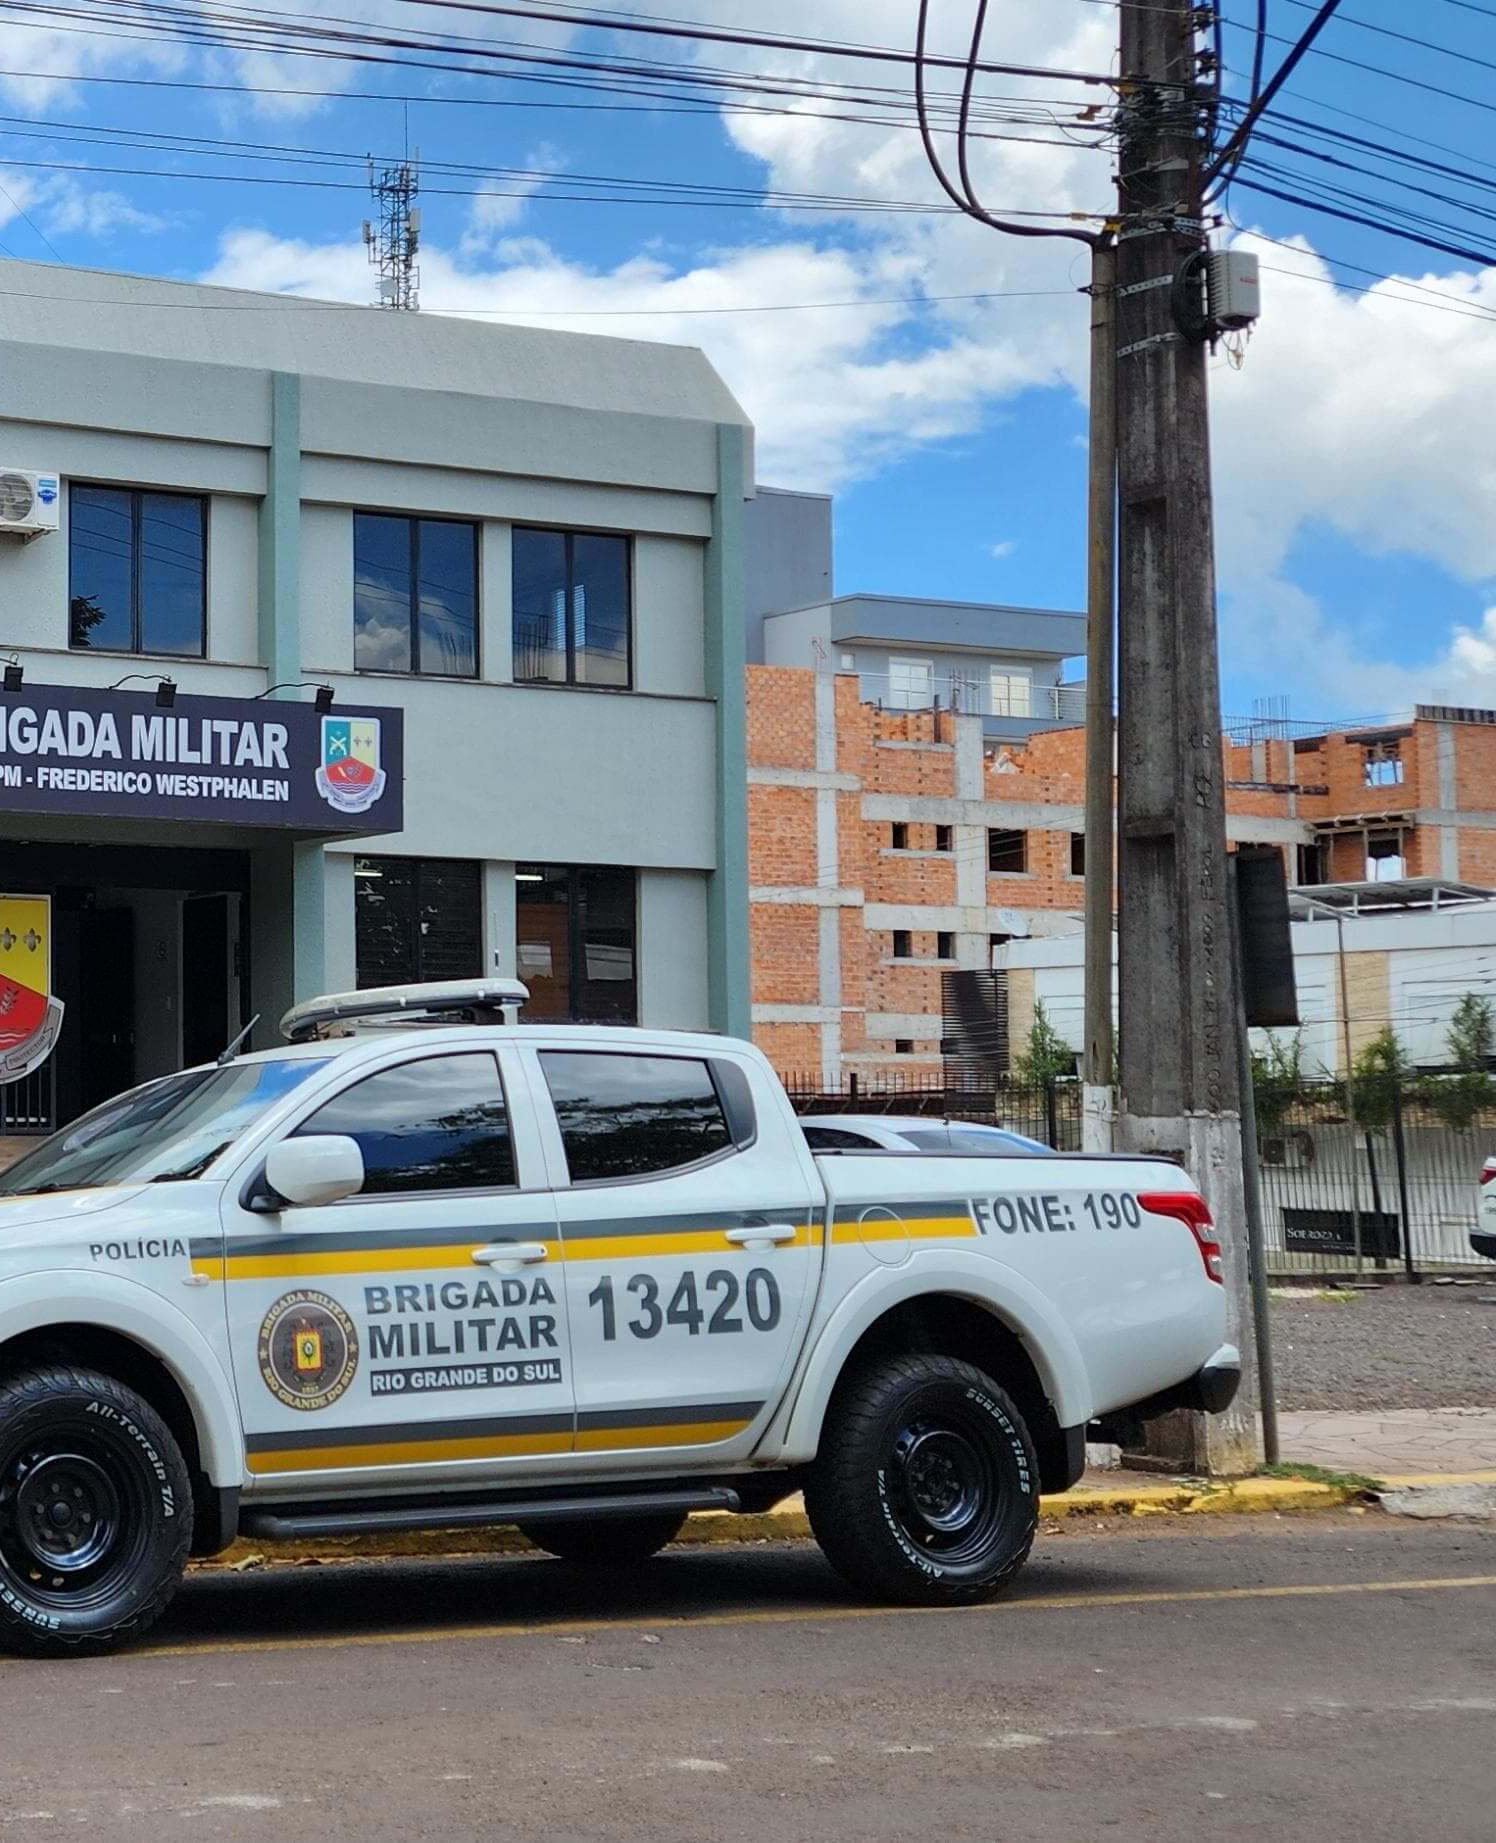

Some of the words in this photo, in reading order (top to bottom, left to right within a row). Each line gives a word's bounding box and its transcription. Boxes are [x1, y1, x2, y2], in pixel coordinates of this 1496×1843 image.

[131, 714, 290, 769] MILITAR
[37, 767, 152, 795] FREDERICO
[156, 773, 289, 801] WESTPHALEN
[971, 1195, 1076, 1235] FONE:
[1083, 1192, 1142, 1230] 190
[89, 1237, 186, 1262] POLÍCIA
[261, 1291, 305, 1339] BRIGADA
[307, 1291, 353, 1333] MILITAR
[364, 1277, 556, 1315] BRIGADA
[588, 1267, 781, 1341] 13420
[368, 1315, 558, 1360] MILITAR
[372, 1374, 404, 1391] RIO
[411, 1368, 488, 1388] GRANDE
[493, 1365, 519, 1383] DO
[524, 1363, 560, 1381] SUL
[85, 1401, 167, 1481] All-Terrain
[161, 1485, 175, 1517] T/A
[965, 1387, 1015, 1435] SUNSET
[1011, 1439, 1030, 1494] TIRES
